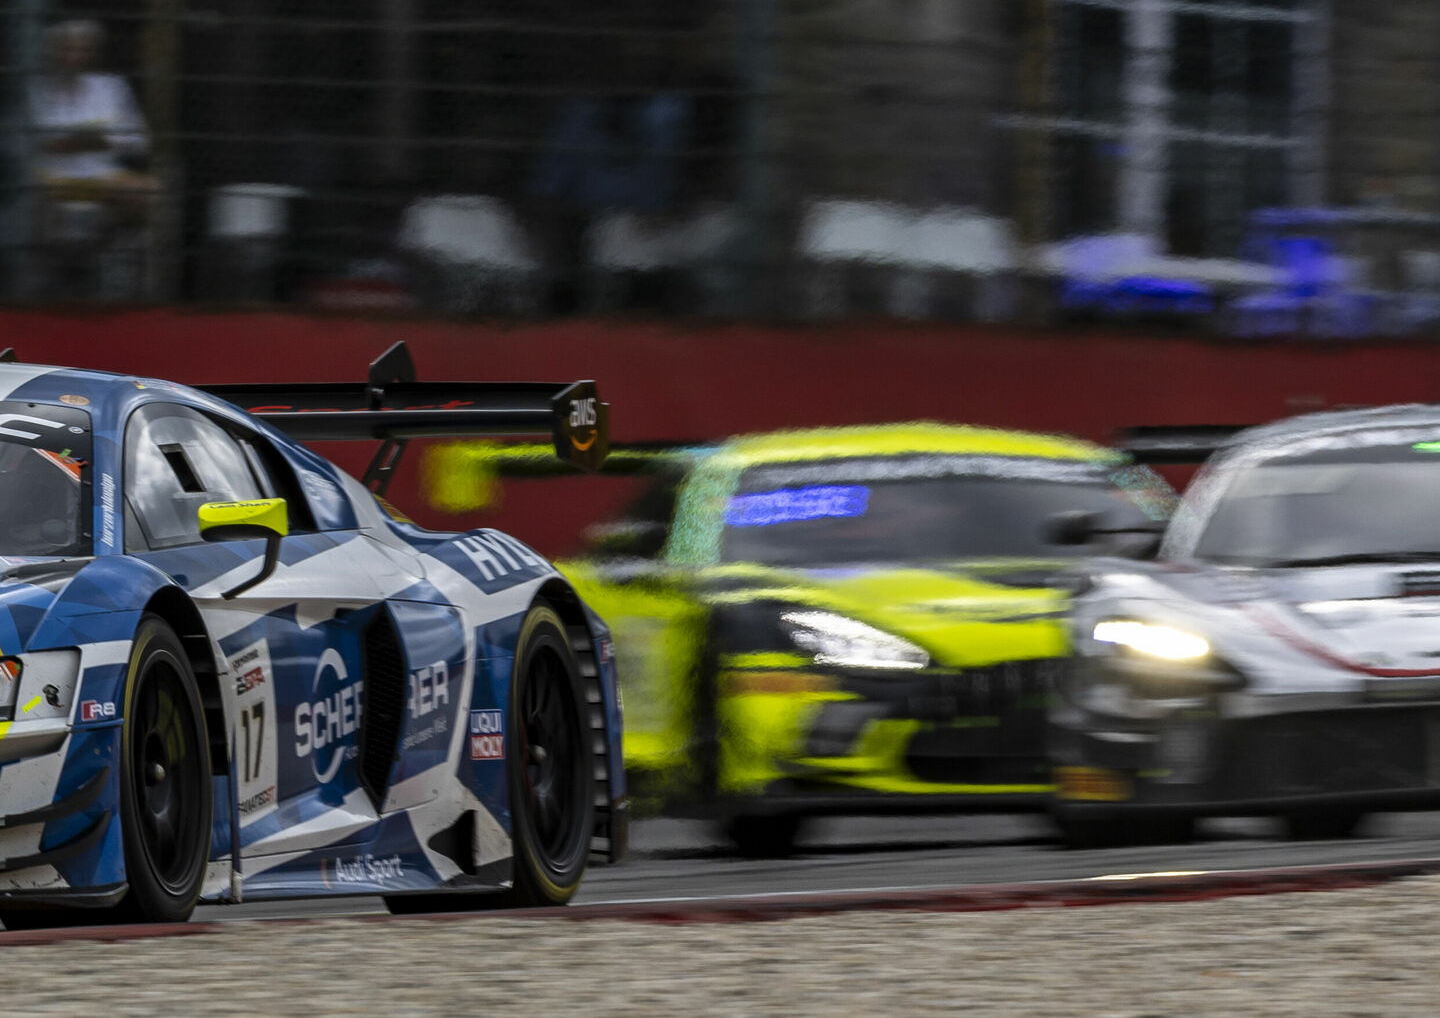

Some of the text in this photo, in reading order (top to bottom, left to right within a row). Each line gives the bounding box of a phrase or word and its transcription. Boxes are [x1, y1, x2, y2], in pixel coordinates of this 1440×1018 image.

[89, 701, 116, 719] R8
[241, 700, 264, 784] 17
[471, 736, 504, 758] MOLY
[336, 854, 404, 885] Audi Sport
